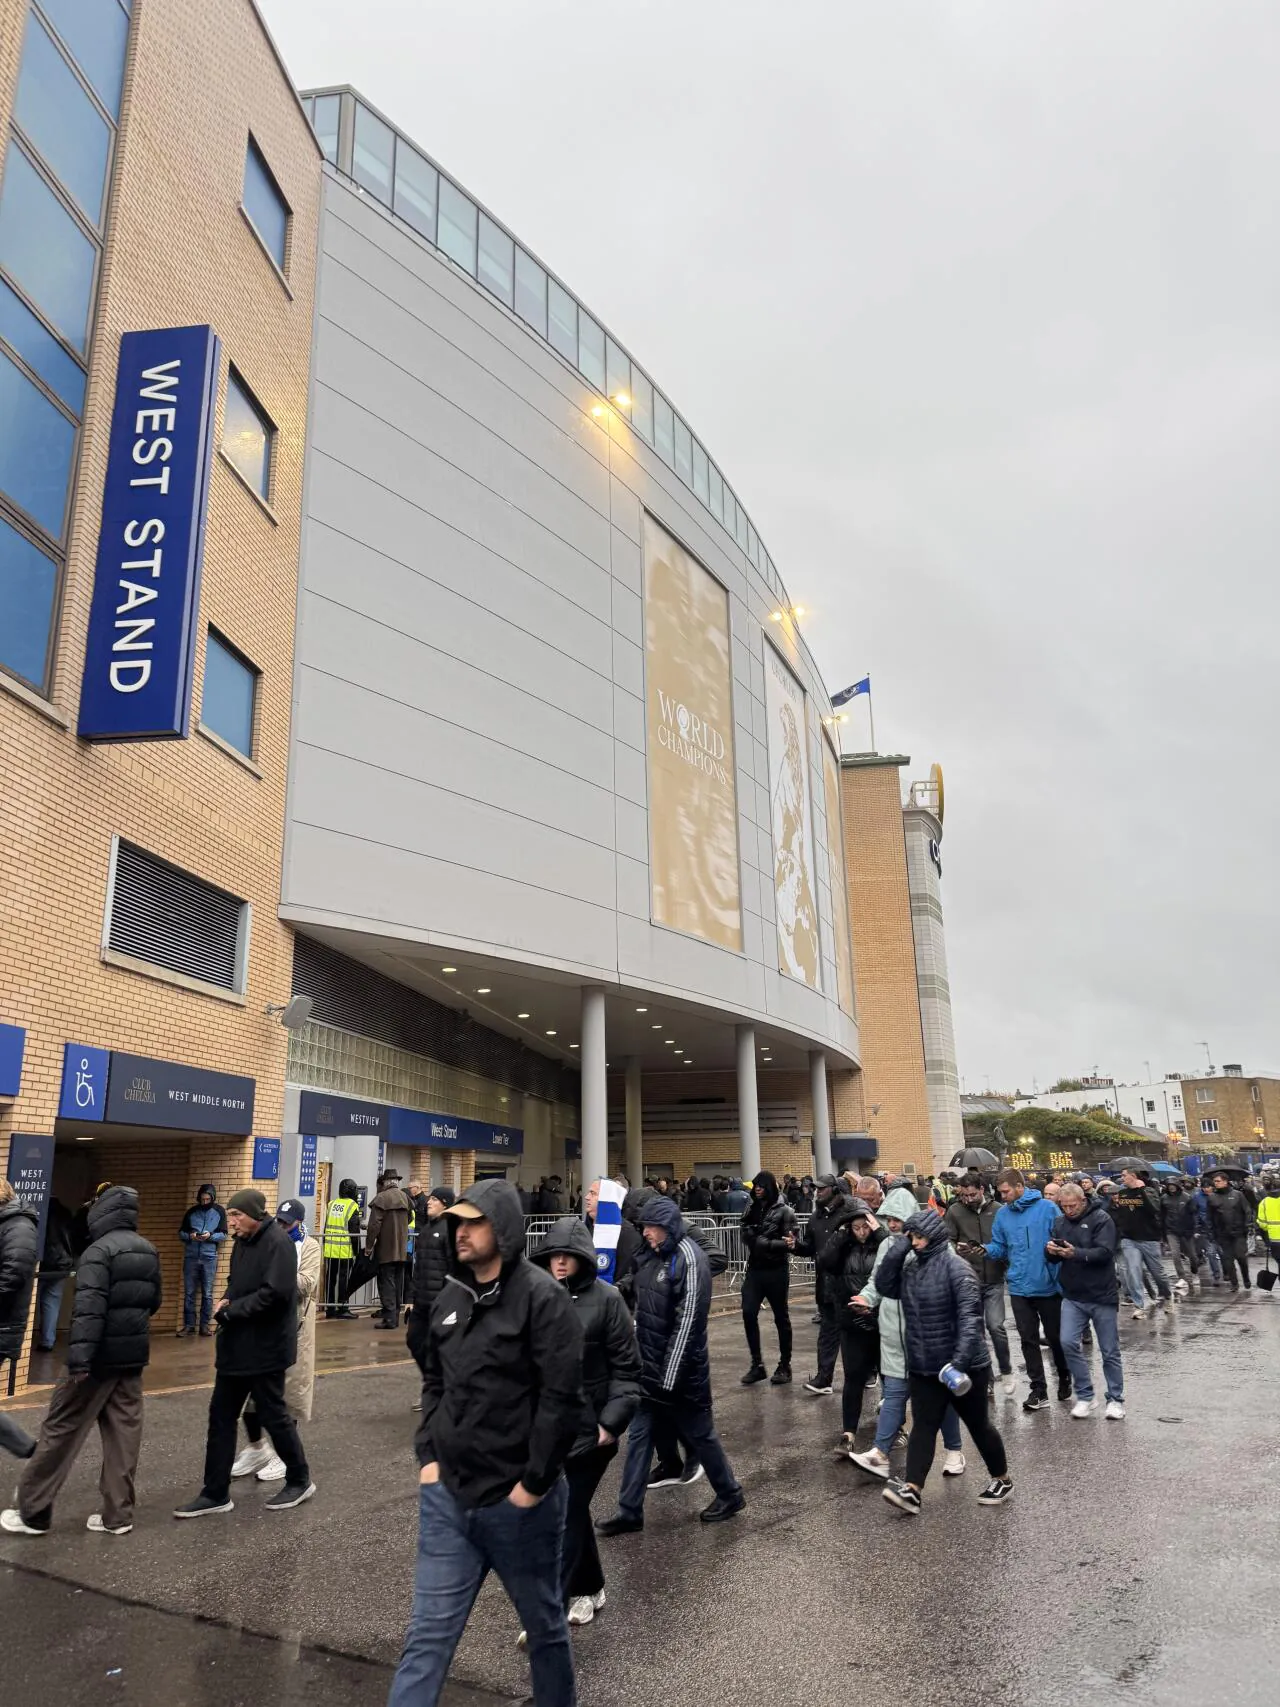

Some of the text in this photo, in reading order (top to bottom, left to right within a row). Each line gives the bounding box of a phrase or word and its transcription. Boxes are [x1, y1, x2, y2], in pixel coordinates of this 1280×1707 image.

[109, 360, 181, 692] WEST STAND
[657, 688, 725, 760] WORLD
[657, 725, 726, 785] CHAMPIONS
[132, 1077, 151, 1090] CLUB
[124, 1088, 156, 1103] CHELSEA
[168, 1090, 245, 1110] WEST MIDDLE NORTH
[350, 1113, 380, 1126] WESTVIEW
[431, 1122, 458, 1139] West Stand
[20, 1169, 43, 1178] WEST
[14, 1181, 47, 1190] MIDDLE
[15, 1193, 43, 1201] NORTH
[332, 1204, 345, 1212] 506
